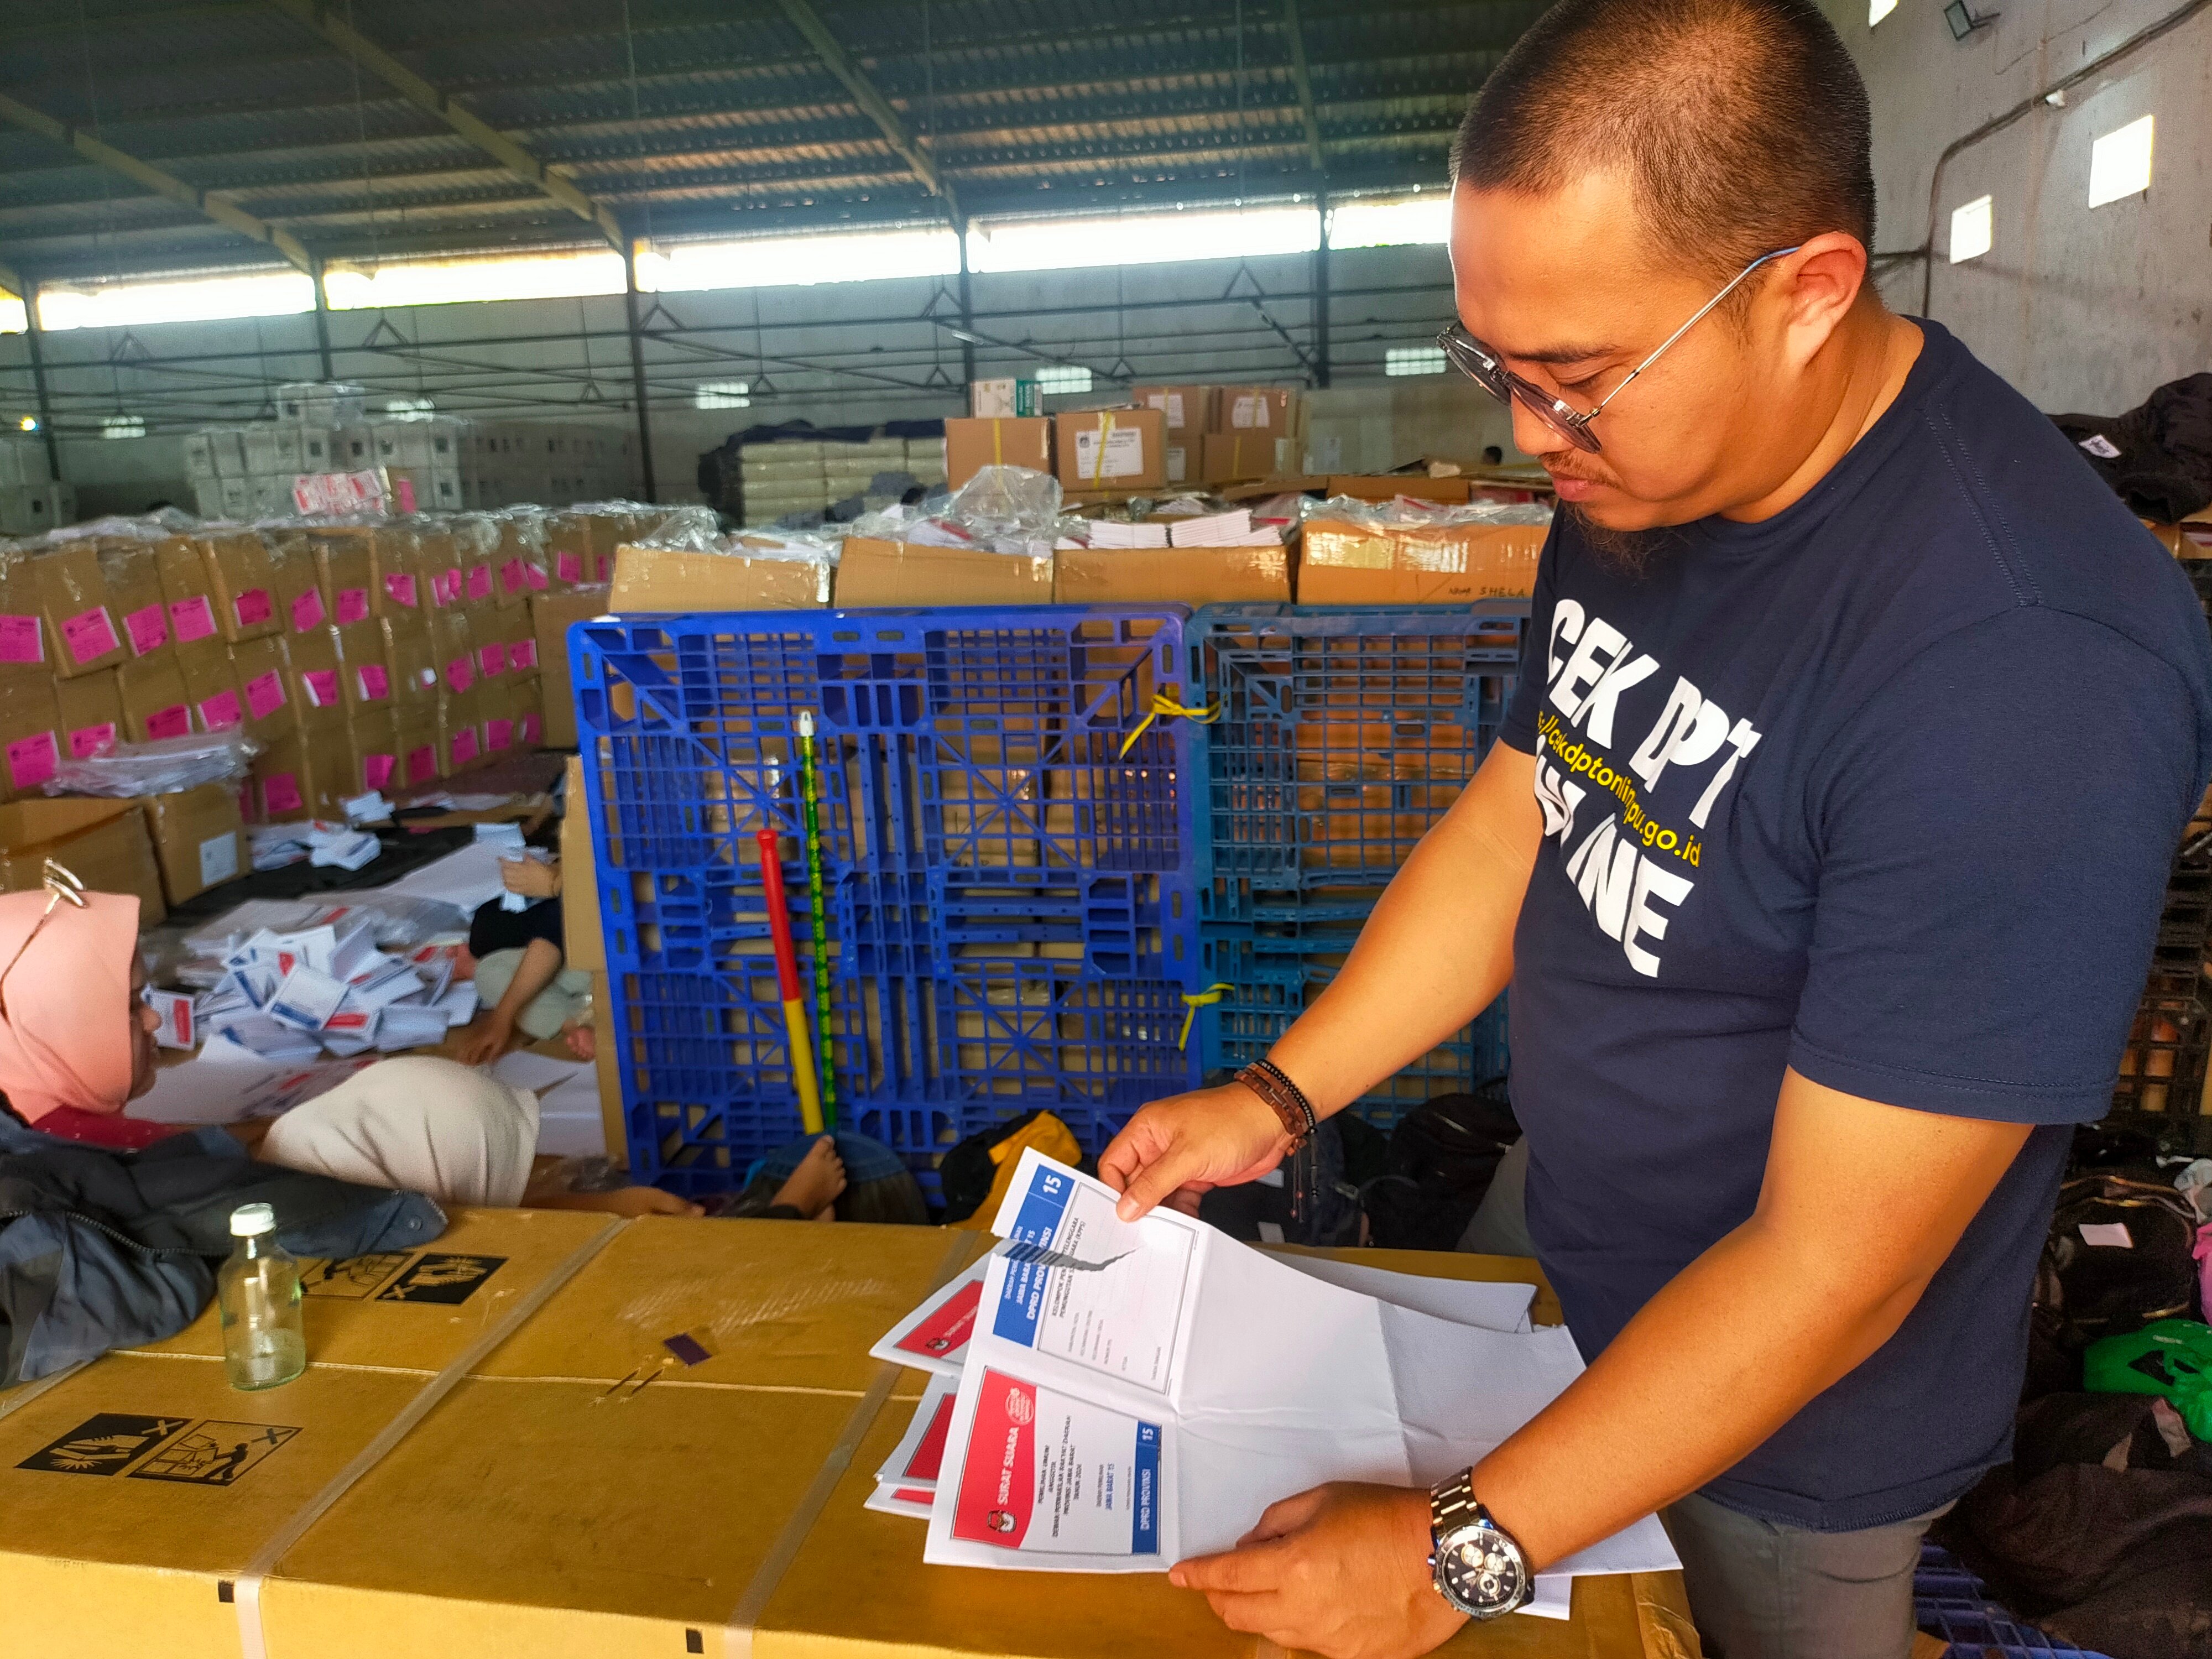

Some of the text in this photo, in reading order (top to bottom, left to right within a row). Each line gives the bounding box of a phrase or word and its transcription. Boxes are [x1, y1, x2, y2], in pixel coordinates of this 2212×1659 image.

[1547, 599, 1762, 830] CEK DPT
[1042, 1174, 1063, 1196] 15
[1026, 1290, 1040, 1319] DPRD
[1003, 1427, 1019, 1467] SUARA
[997, 1467, 1013, 1504] SURAT
[1140, 1427, 1153, 1530] DPRD PROVINSI 15
